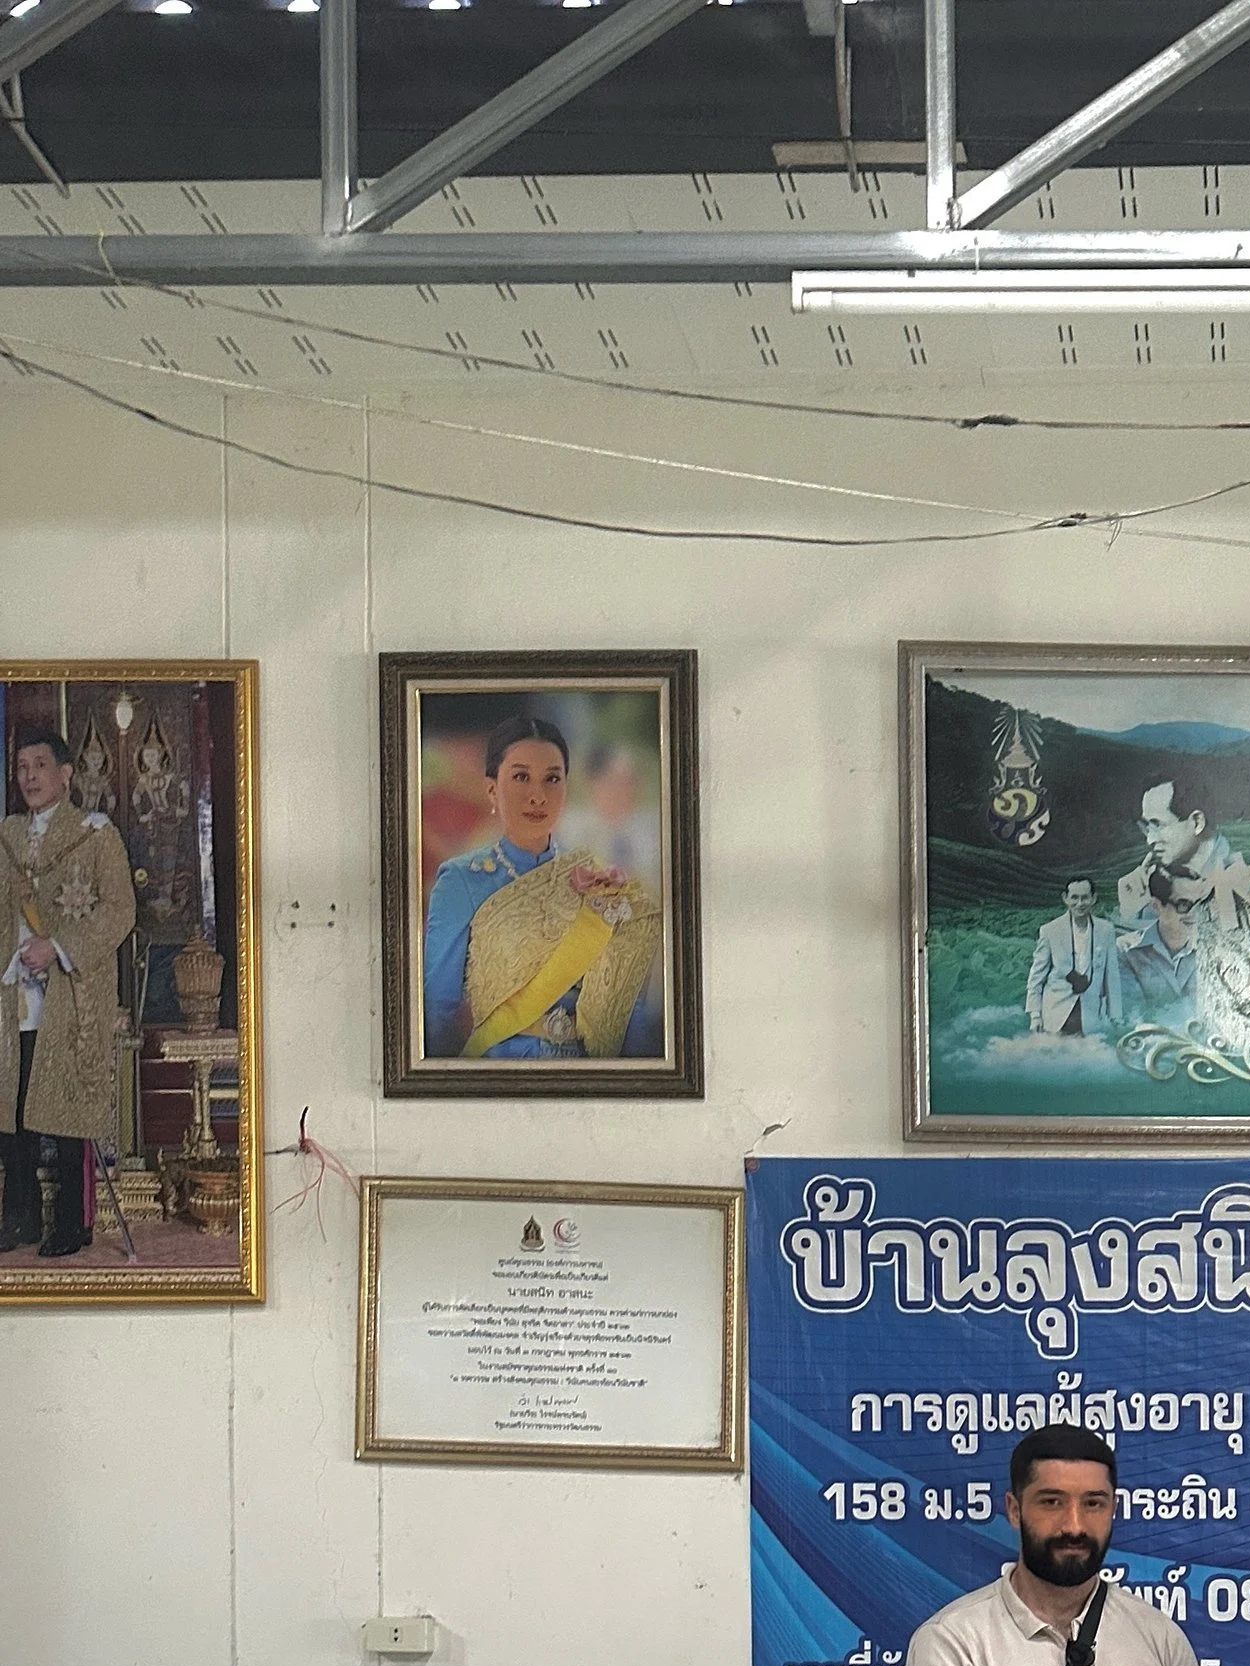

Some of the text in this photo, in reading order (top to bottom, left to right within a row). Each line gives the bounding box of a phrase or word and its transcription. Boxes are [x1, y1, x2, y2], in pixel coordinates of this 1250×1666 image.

[851, 1372, 1243, 1454] การดูแลผ้สูงอายุ
[824, 1483, 906, 1521] 158
[924, 1483, 992, 1521] ม.5
[1113, 1474, 1237, 1520] กระถิน
